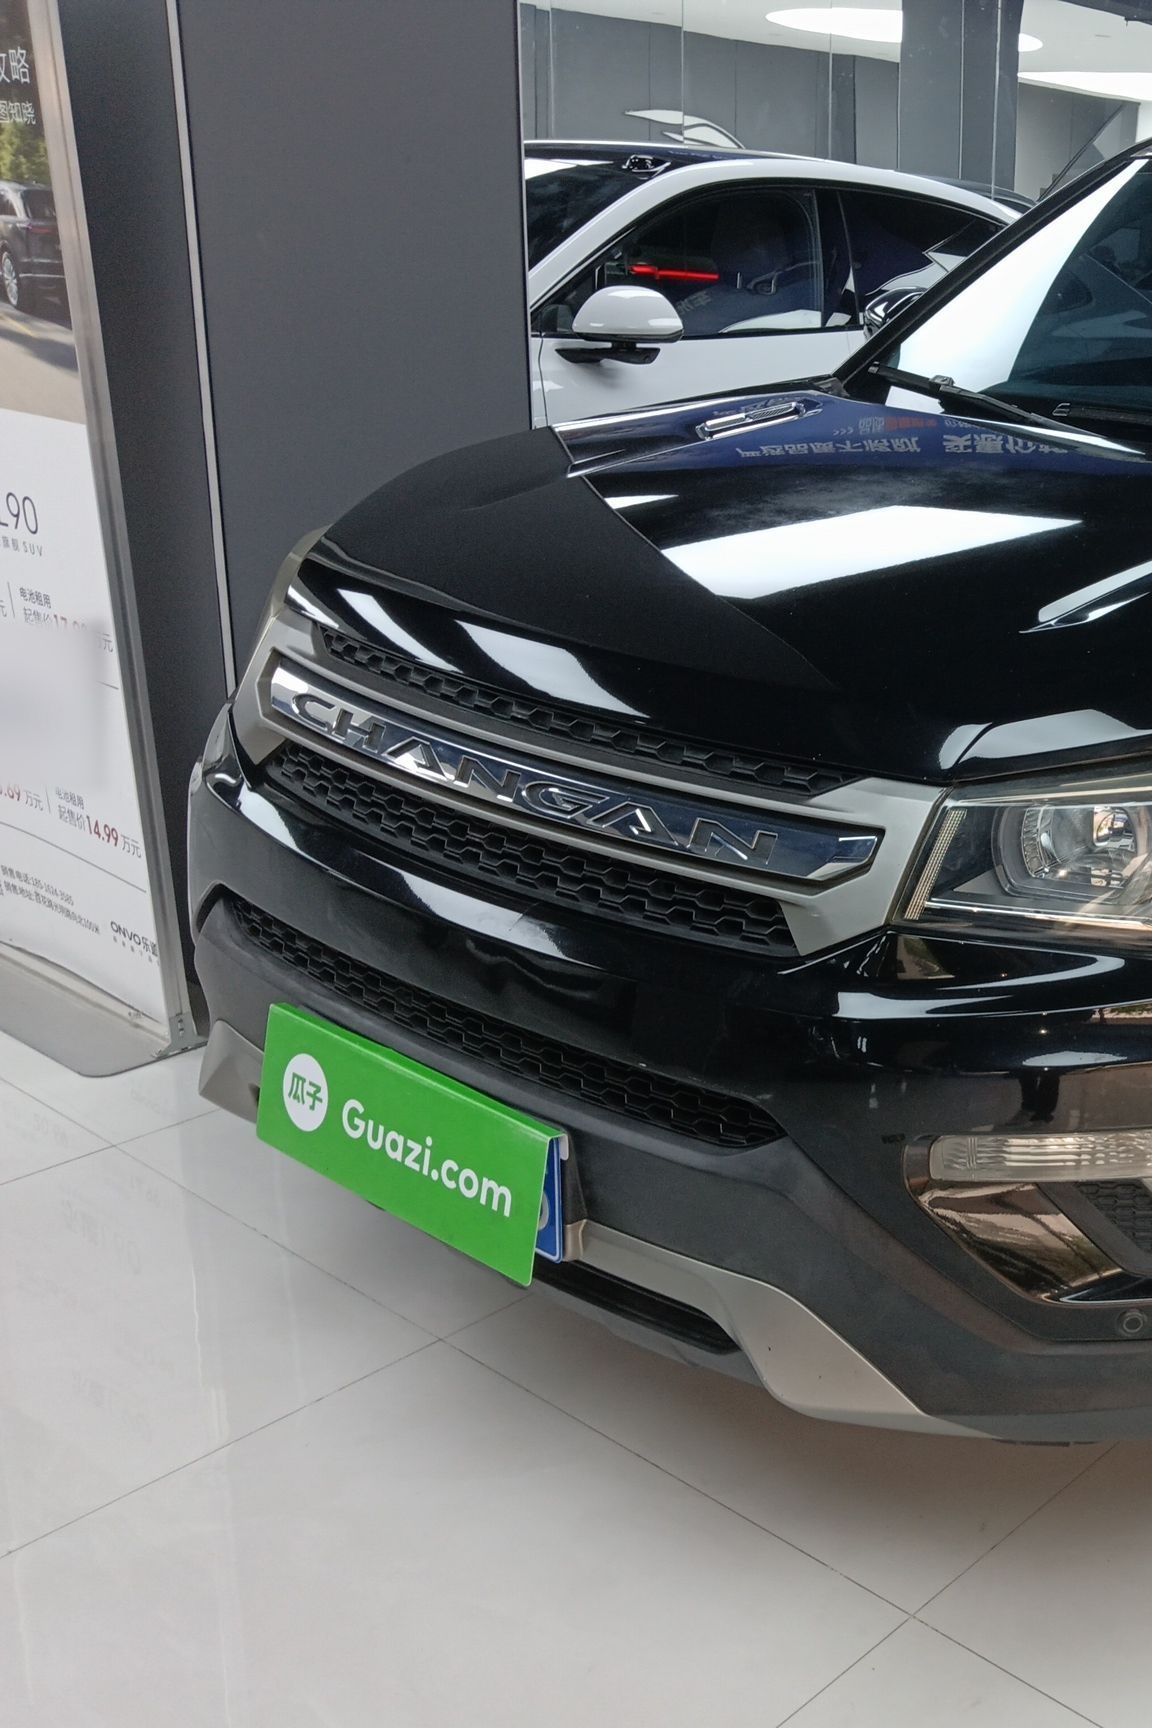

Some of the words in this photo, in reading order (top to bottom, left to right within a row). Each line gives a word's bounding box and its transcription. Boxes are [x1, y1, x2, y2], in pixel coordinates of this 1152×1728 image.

[290, 692, 780, 866] CHANGAN
[288, 1071, 324, 1112] 瓜子
[341, 1098, 513, 1219] Guazi.com
